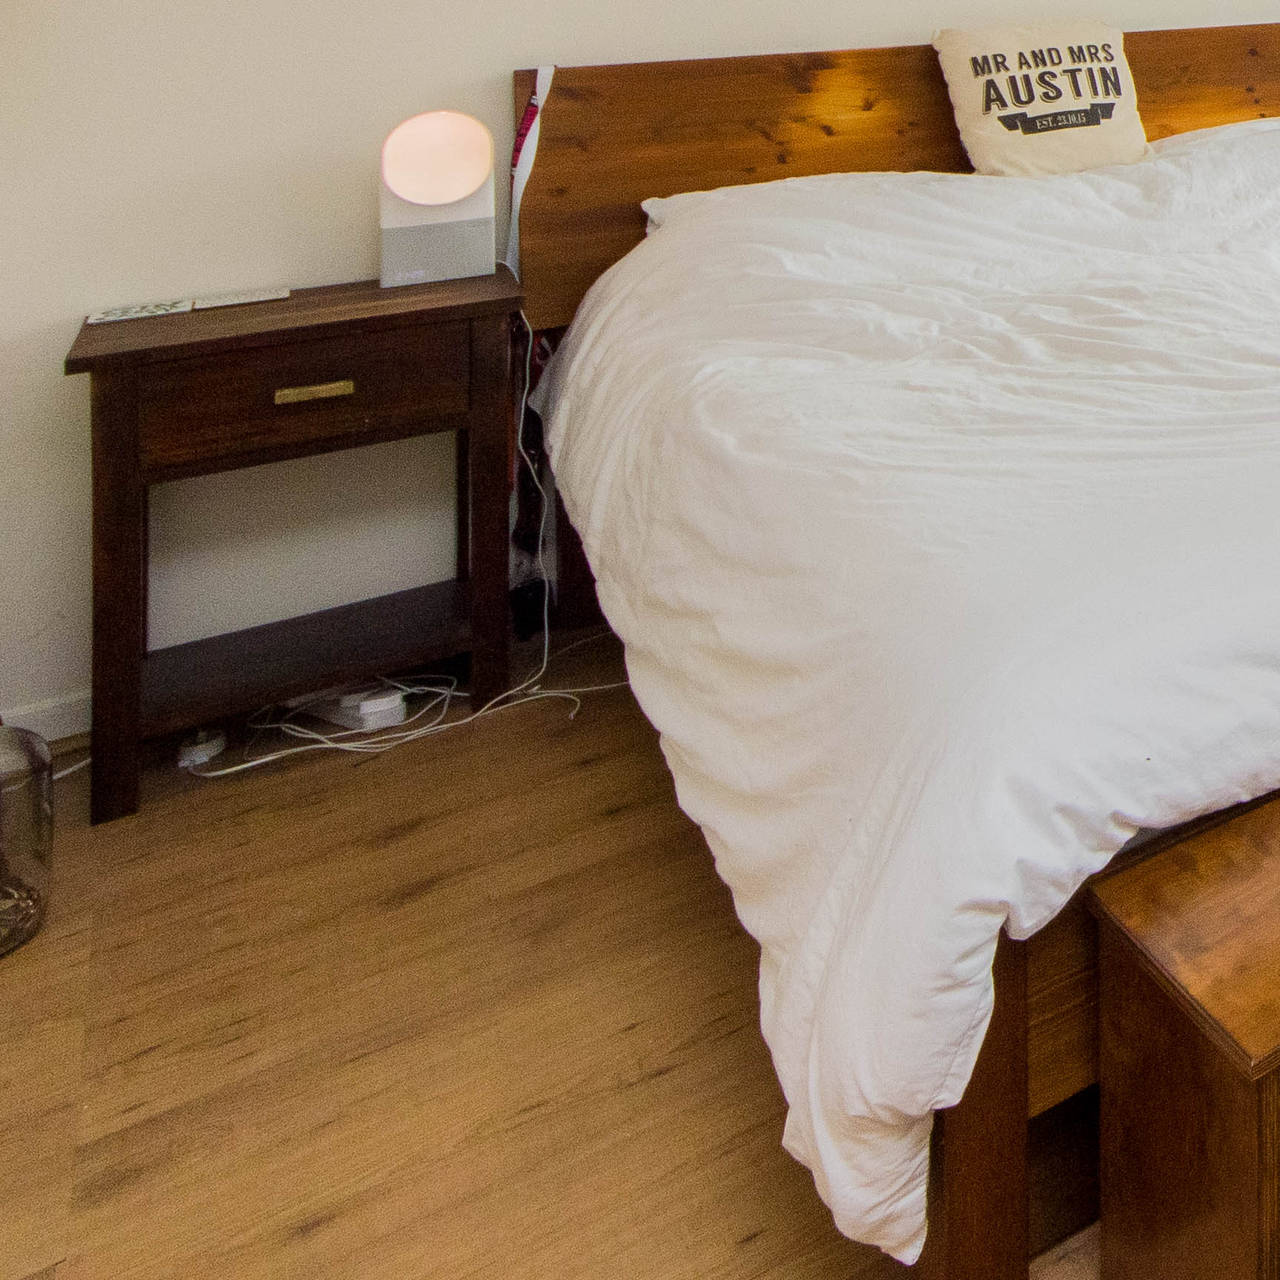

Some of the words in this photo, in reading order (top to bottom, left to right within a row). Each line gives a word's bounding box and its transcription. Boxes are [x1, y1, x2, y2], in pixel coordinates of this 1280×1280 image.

[971, 54, 1010, 77] MR
[1018, 47, 1062, 70] AND
[1067, 43, 1114, 64] MRS
[982, 66, 1122, 115] AUSTIN
